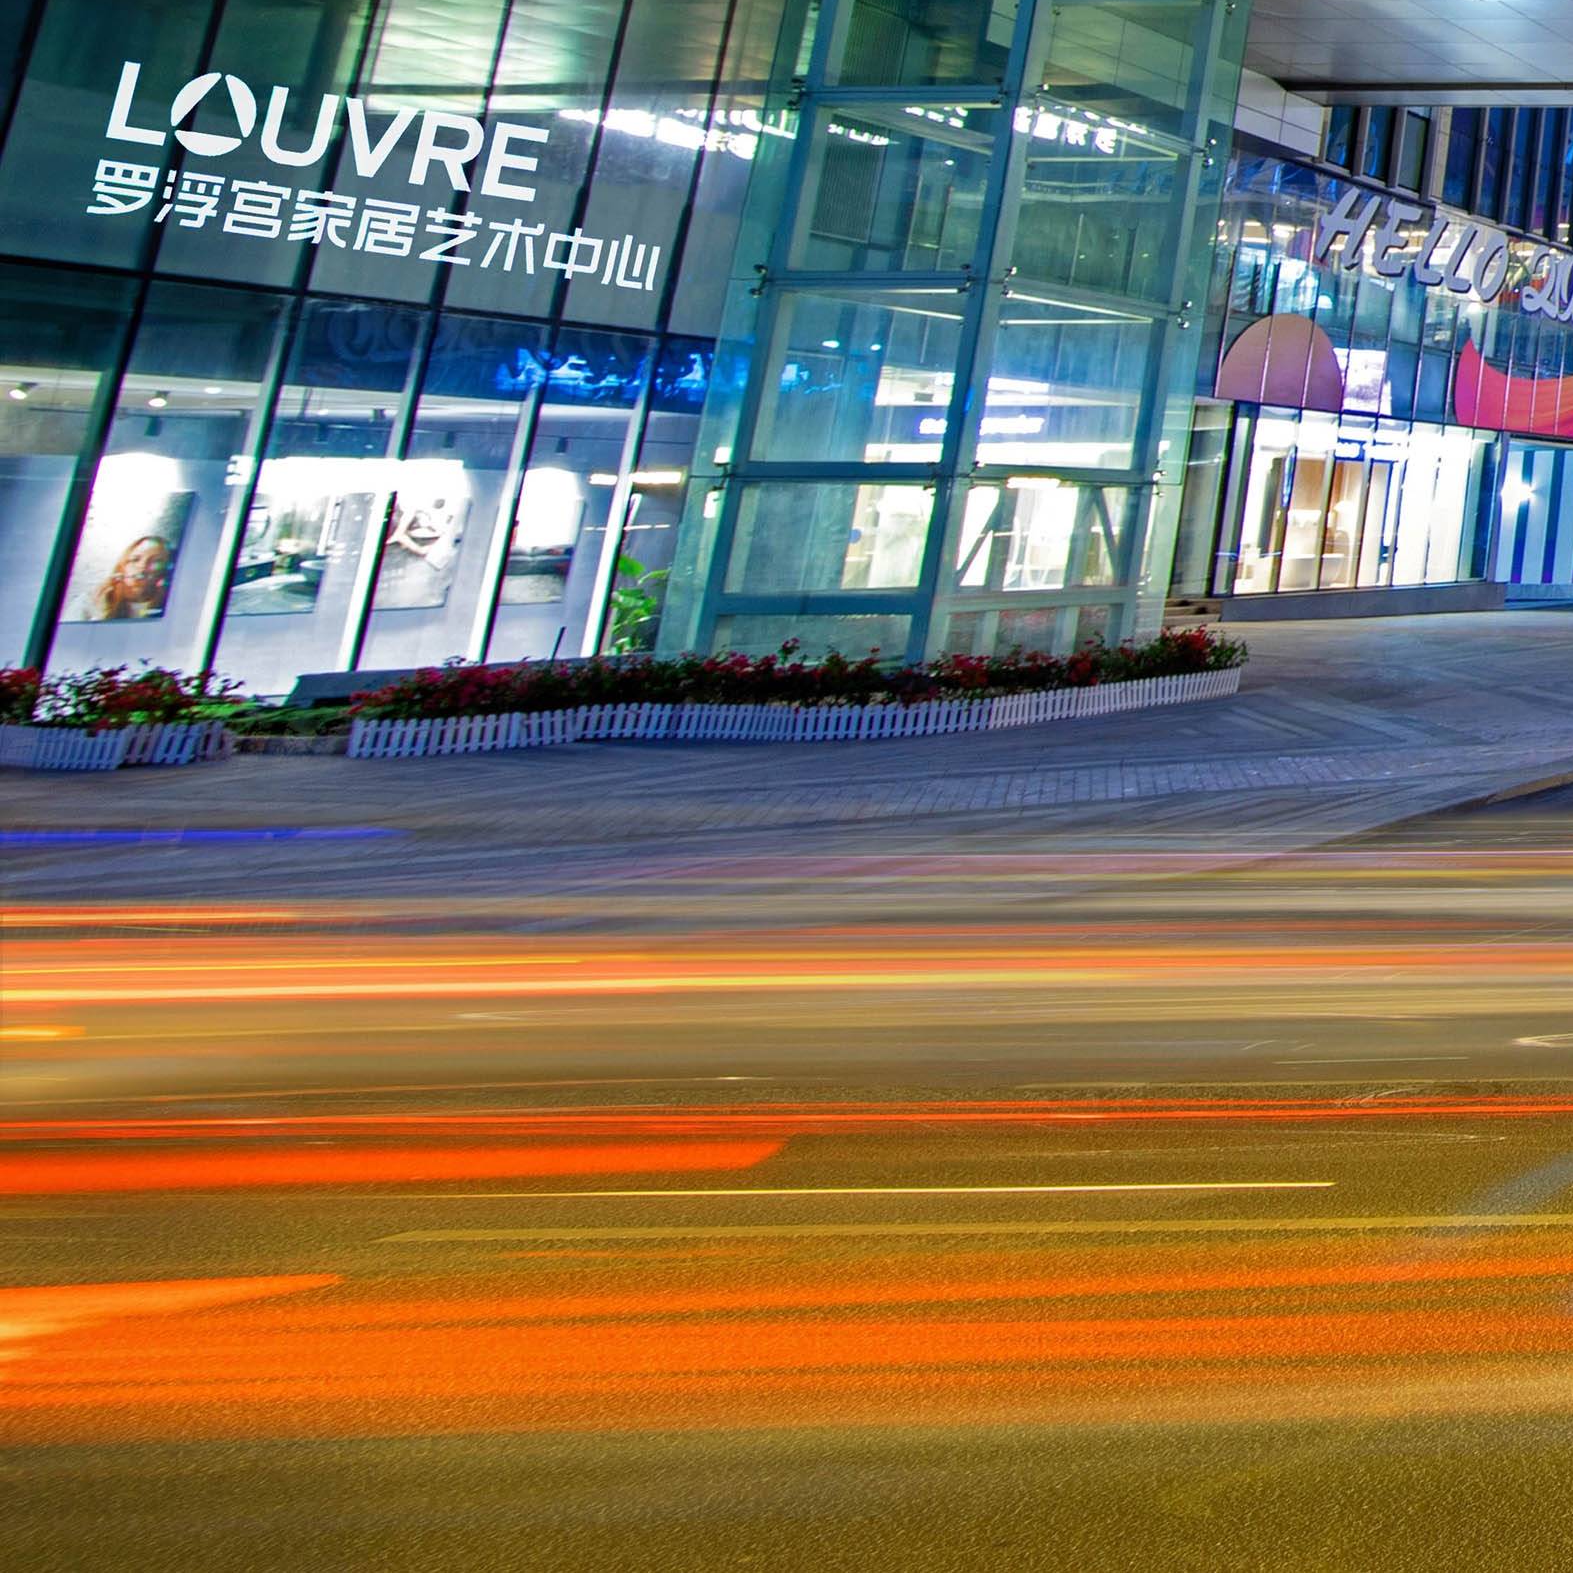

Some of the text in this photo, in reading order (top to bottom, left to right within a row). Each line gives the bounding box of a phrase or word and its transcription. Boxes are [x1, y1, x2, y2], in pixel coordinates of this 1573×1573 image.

[104, 61, 551, 203] LOUVRE
[86, 157, 662, 291] 罗浮宫家居艺术中心
[1315, 186, 1509, 303] HELLO
